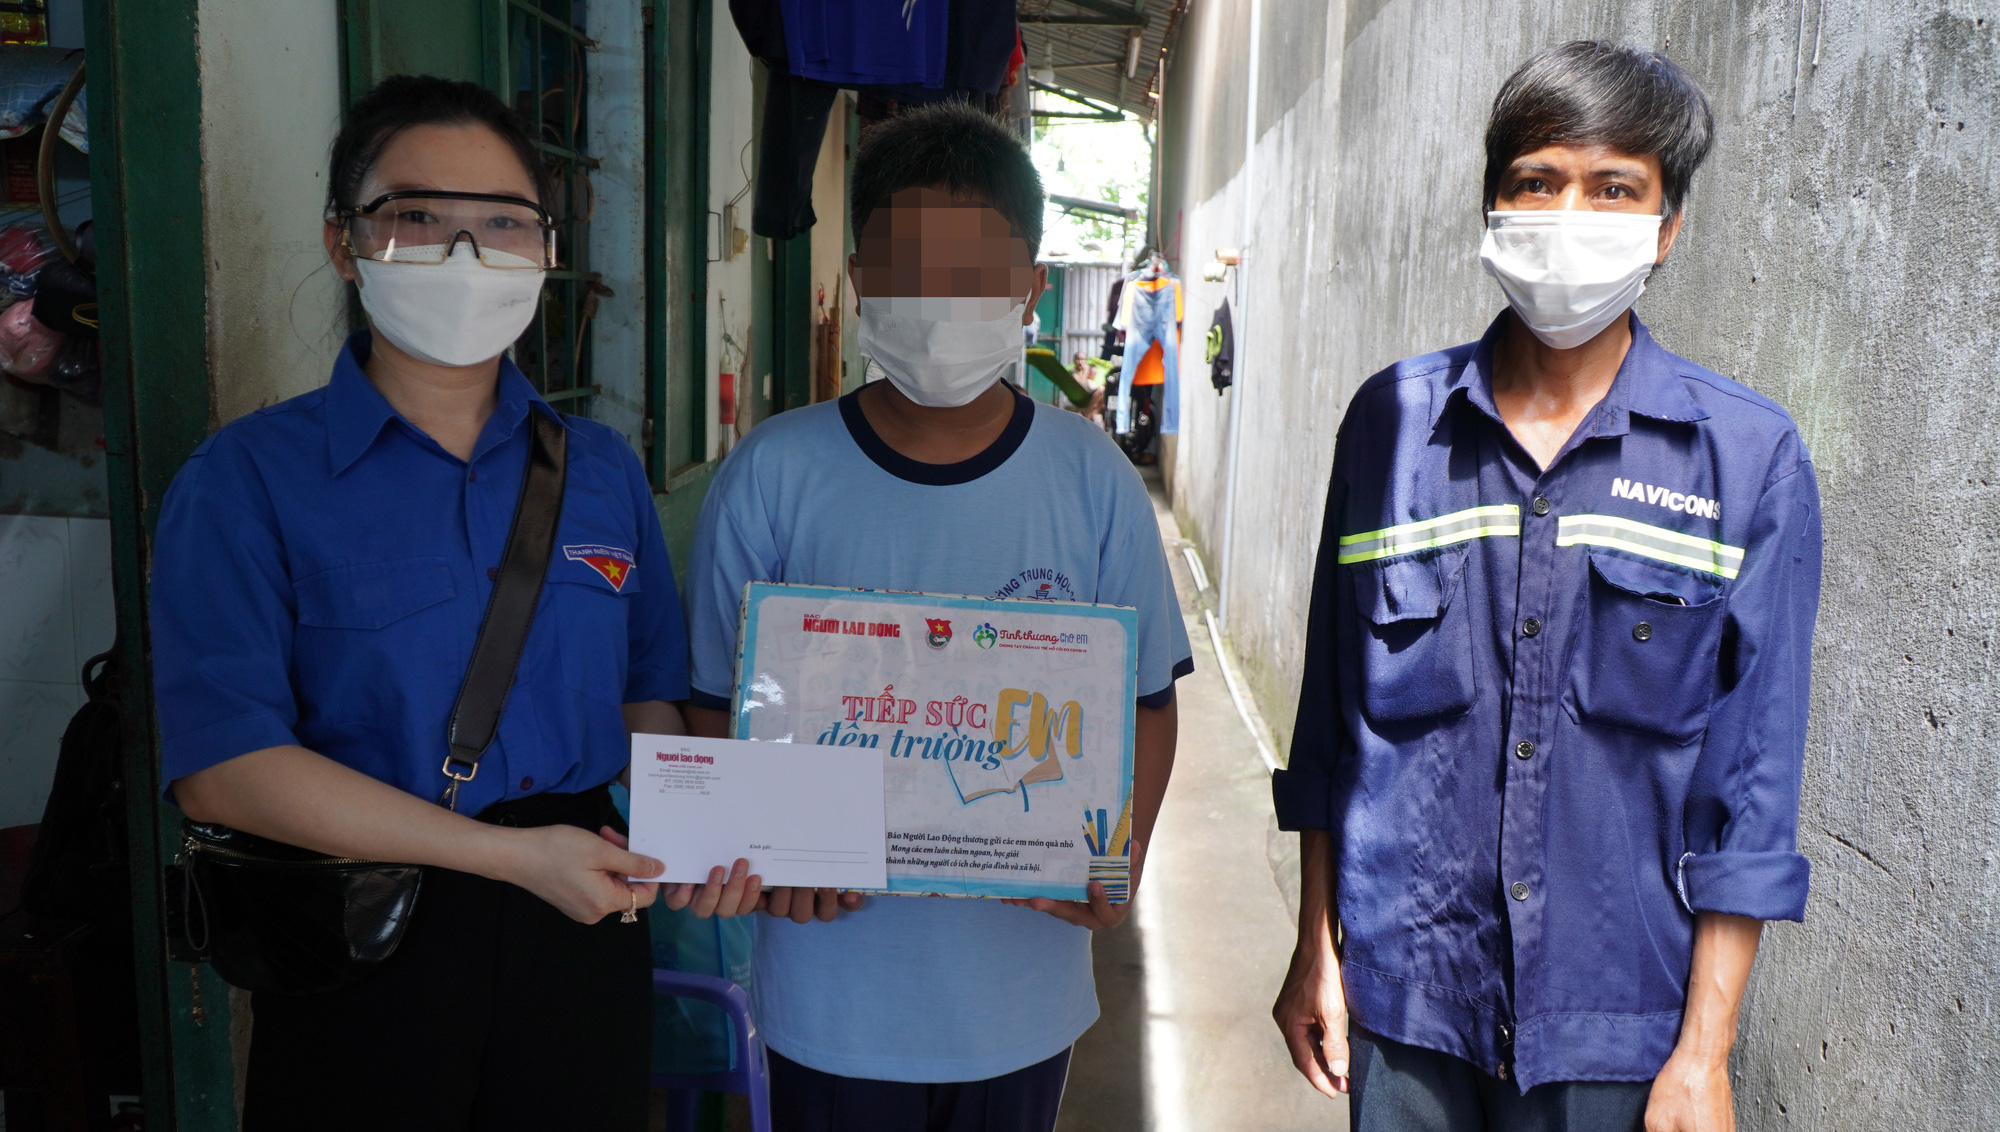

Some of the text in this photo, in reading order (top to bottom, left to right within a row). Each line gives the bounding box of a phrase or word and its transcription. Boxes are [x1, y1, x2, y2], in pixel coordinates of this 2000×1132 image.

[1611, 477, 1721, 520] NAVICONS
[568, 548, 593, 556] THANH
[1019, 567, 1053, 583] TRUNG
[842, 621, 866, 636] LAO
[868, 622, 900, 638] ĐỘNG
[1076, 633, 1088, 645] em
[842, 684, 1083, 762] TIẾP SỨC EM
[816, 711, 1008, 771] đến trường
[680, 753, 693, 763] lao
[903, 832, 926, 842] Người
[941, 834, 961, 844] Động
[962, 835, 988, 845] thương
[1002, 837, 1014, 845] các
[1028, 838, 1044, 846] món
[1045, 840, 1058, 848] quà
[1059, 840, 1074, 848] nhỏ
[890, 845, 910, 854] Mong
[911, 845, 922, 853] các
[934, 846, 950, 854] luôn
[950, 846, 969, 855] chăm
[969, 849, 993, 857] ngoan,
[994, 849, 1005, 858] học
[1005, 850, 1020, 859] giỏi
[886, 857, 906, 865] thành
[907, 857, 929, 867] những
[929, 859, 950, 868] người
[969, 860, 980, 868] cho
[981, 862, 993, 870] gia
[993, 861, 1009, 870] đình
[1010, 862, 1018, 870] và
